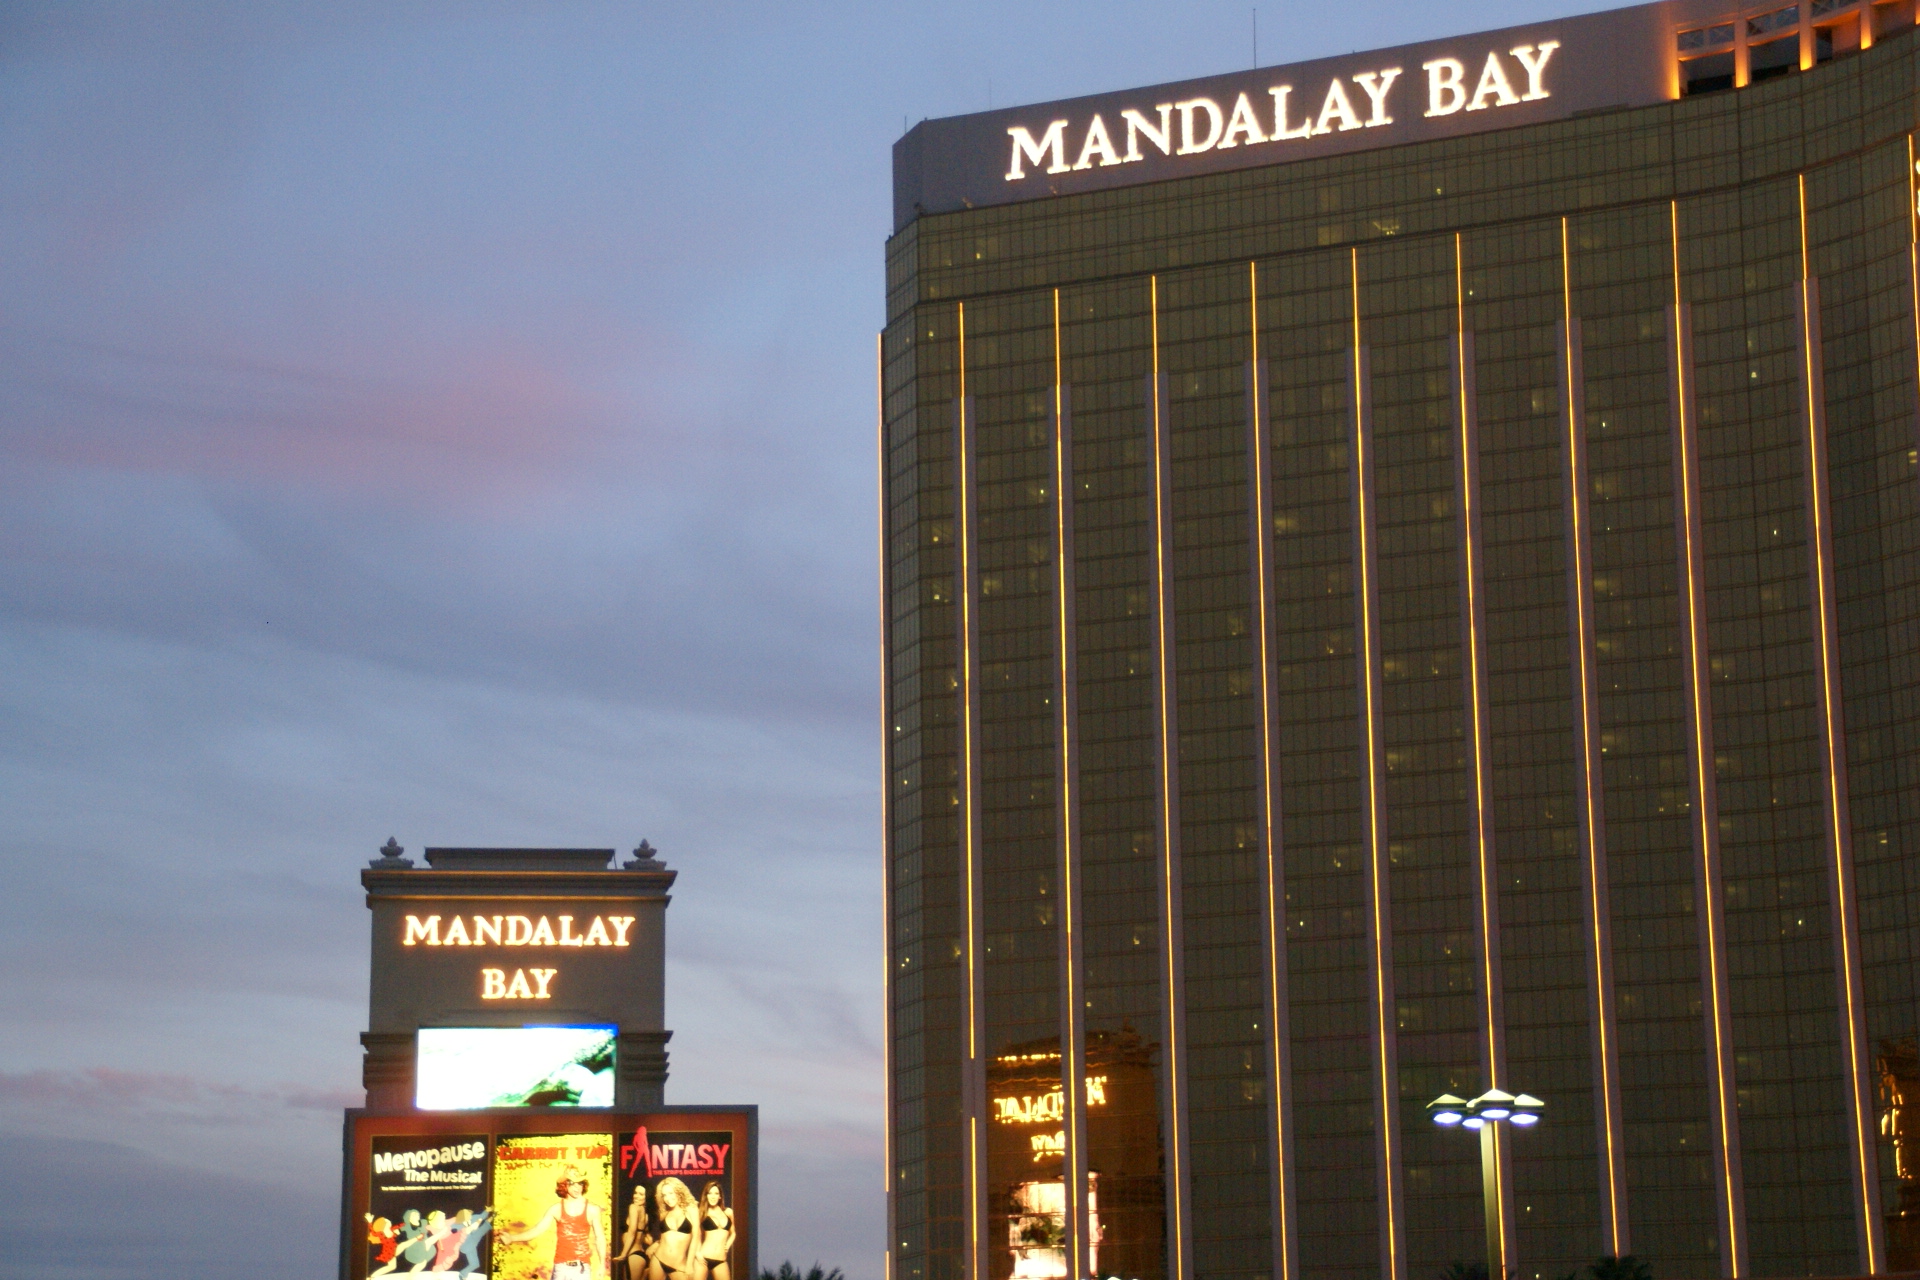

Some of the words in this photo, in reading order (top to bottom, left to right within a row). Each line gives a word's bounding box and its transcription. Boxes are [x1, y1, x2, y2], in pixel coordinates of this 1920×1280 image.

[1004, 66, 1403, 181] MANDALAY
[1422, 40, 1560, 118] BAY
[402, 914, 636, 948] MANDALAY
[481, 967, 558, 1000] BAY
[374, 1141, 485, 1174] Menopause
[403, 1169, 430, 1182] The
[430, 1169, 483, 1184] Musical
